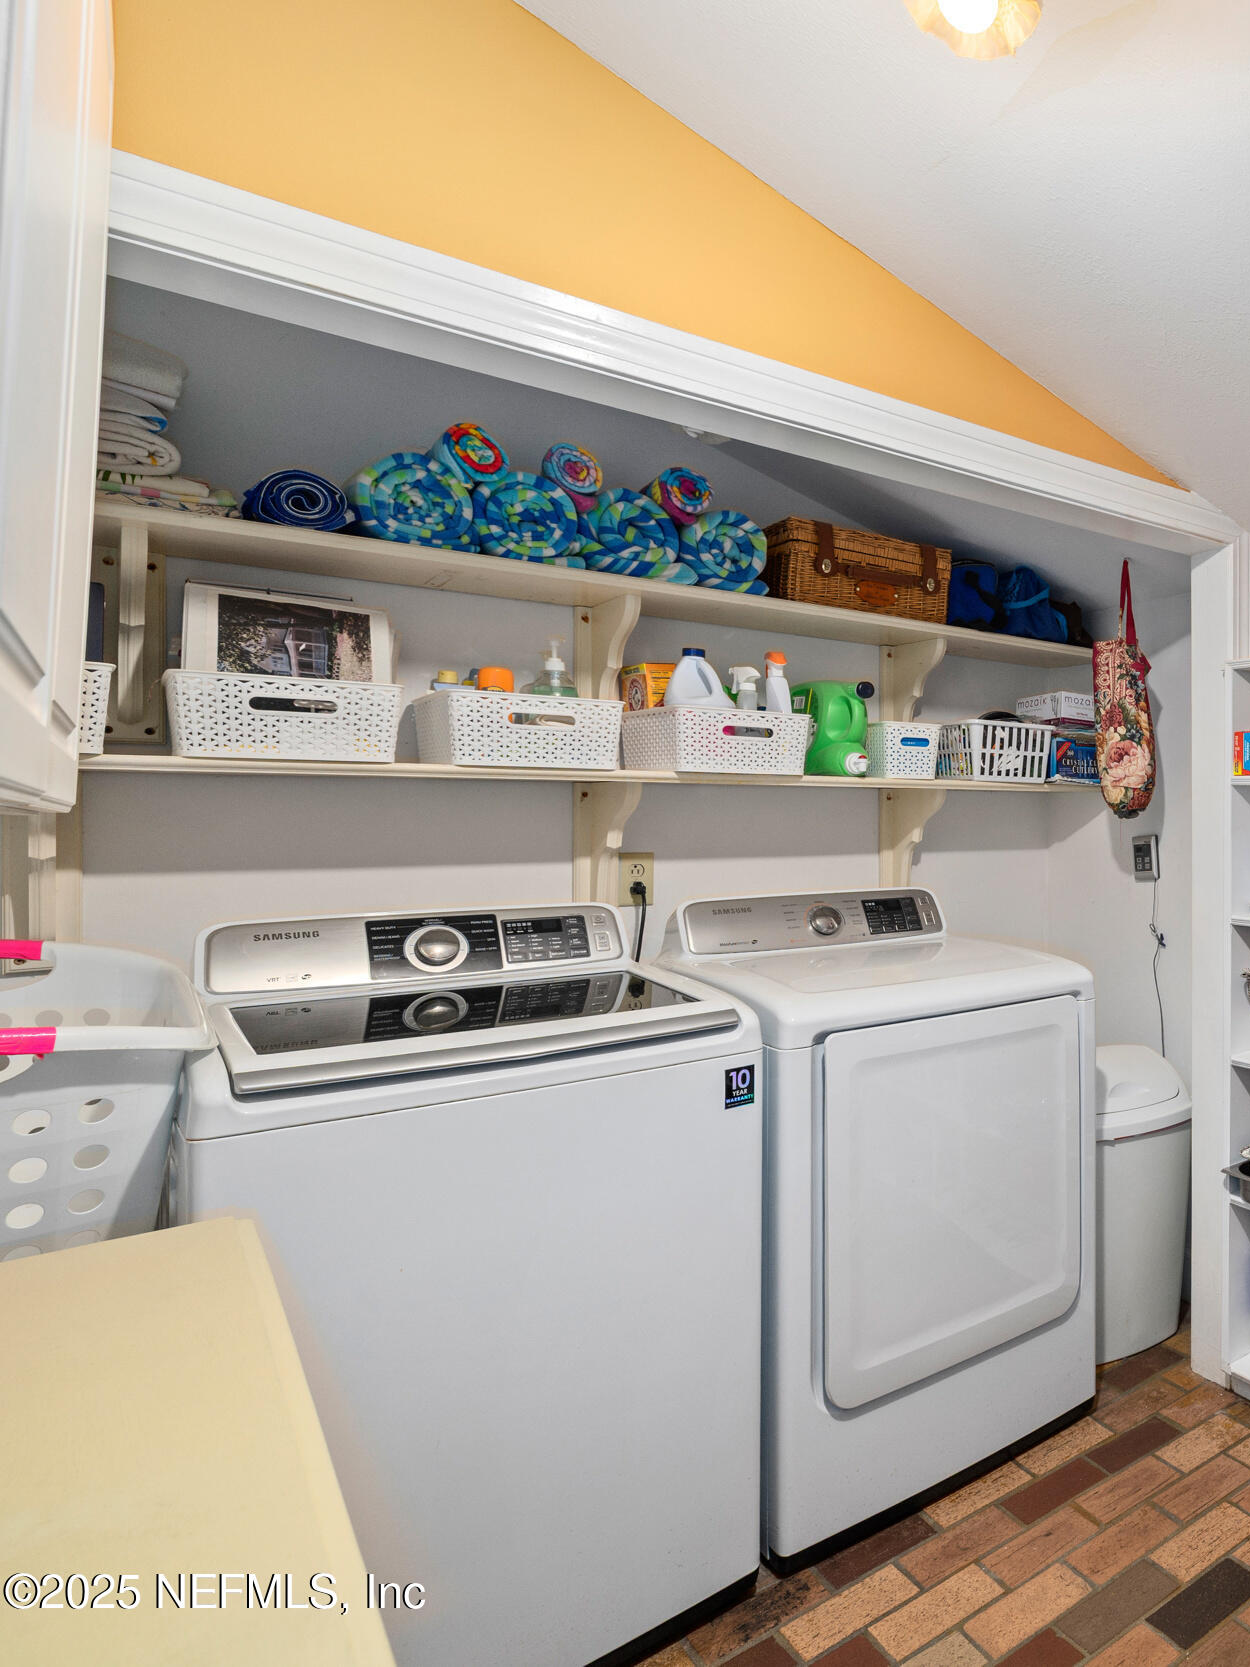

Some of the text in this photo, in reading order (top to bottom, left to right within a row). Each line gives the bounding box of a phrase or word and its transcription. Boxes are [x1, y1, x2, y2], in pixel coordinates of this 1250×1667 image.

[1017, 696, 1047, 709] mozaik
[1064, 696, 1094, 707] mozai
[1072, 765, 1098, 775] CUTLERY
[712, 906, 752, 916] SAMSUNG
[253, 930, 320, 942] SAMSUNG
[729, 1068, 751, 1090] 10
[732, 1088, 748, 1097] YEAR
[726, 1093, 754, 1104] WARRANTY
